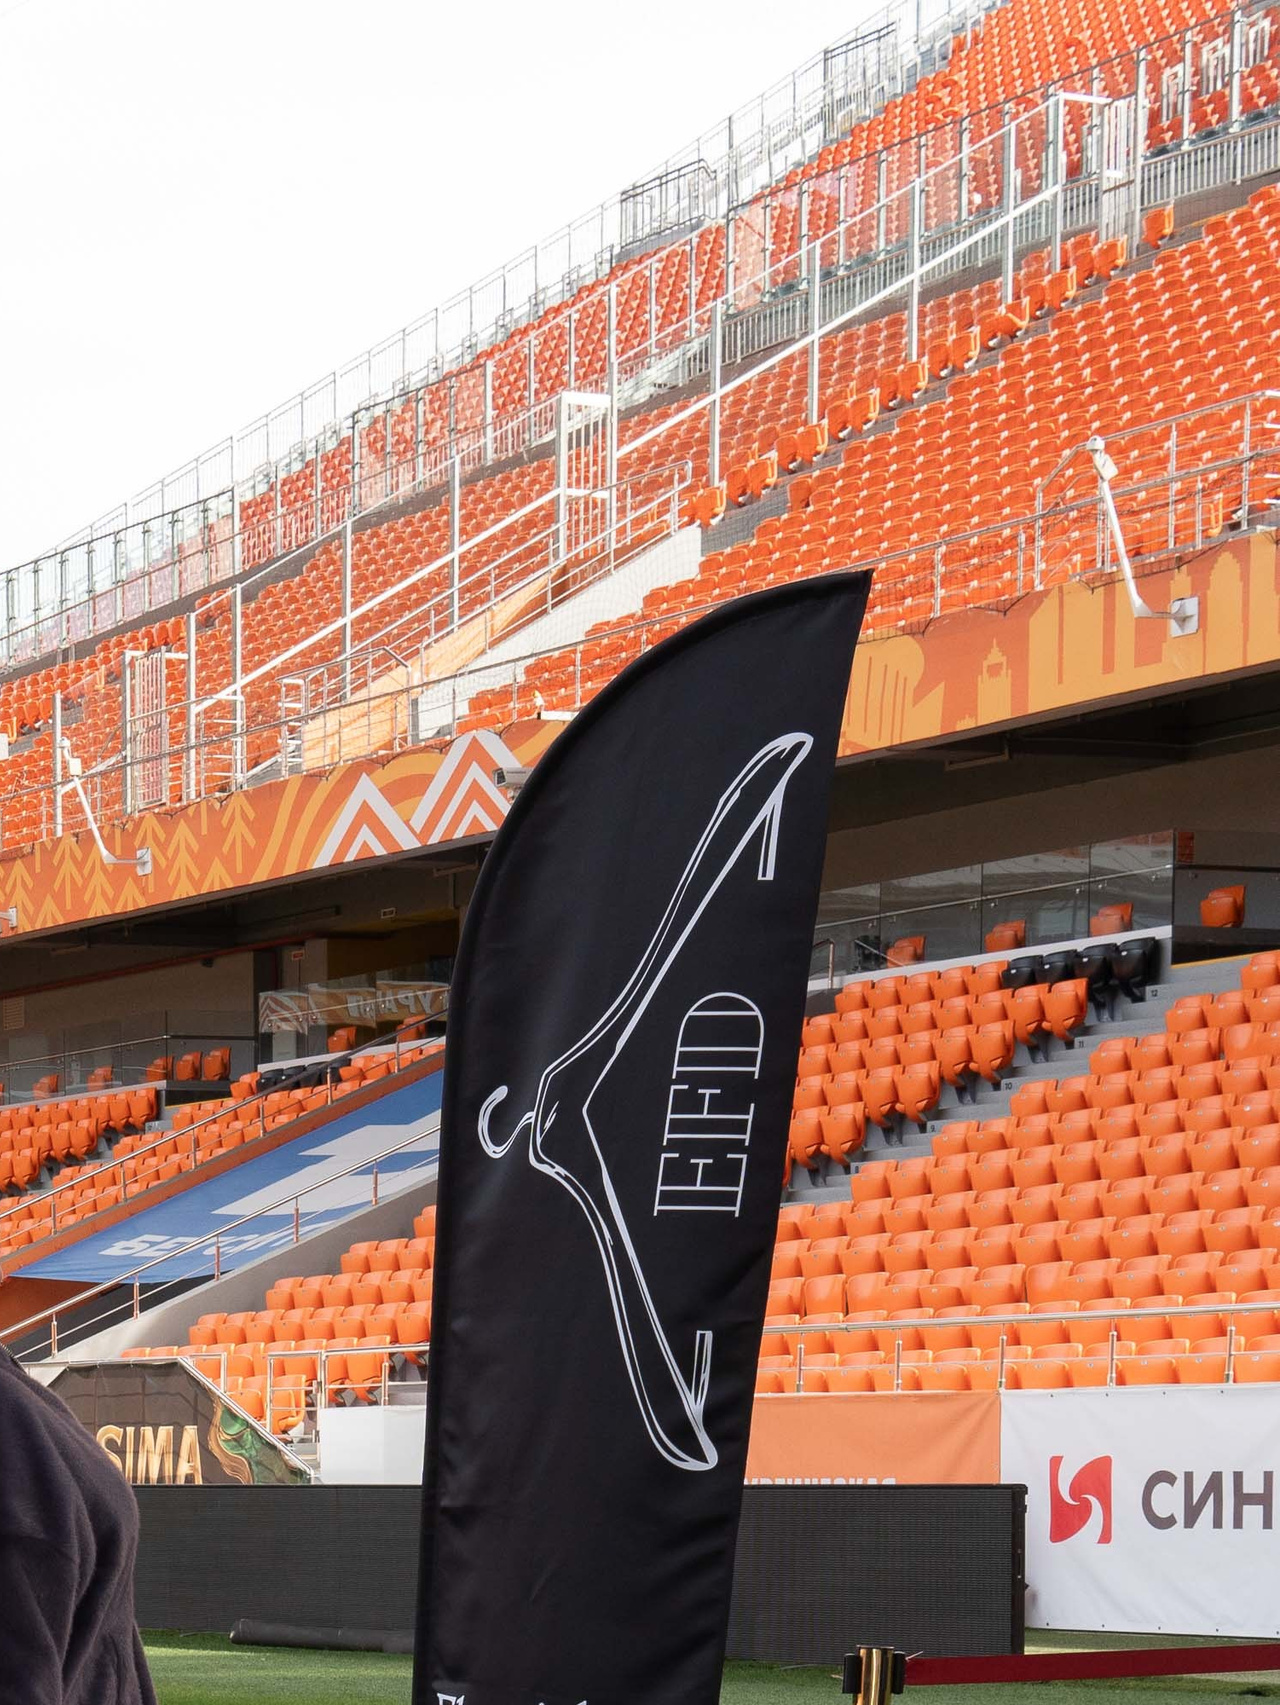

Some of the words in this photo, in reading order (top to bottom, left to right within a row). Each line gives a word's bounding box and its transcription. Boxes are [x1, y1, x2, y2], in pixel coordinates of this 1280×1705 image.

[653, 991, 765, 1218] EFD
[1004, 1081, 1013, 1090] 10
[96, 1425, 203, 1484] SIMA
[1141, 1469, 1274, 1530] СИН
